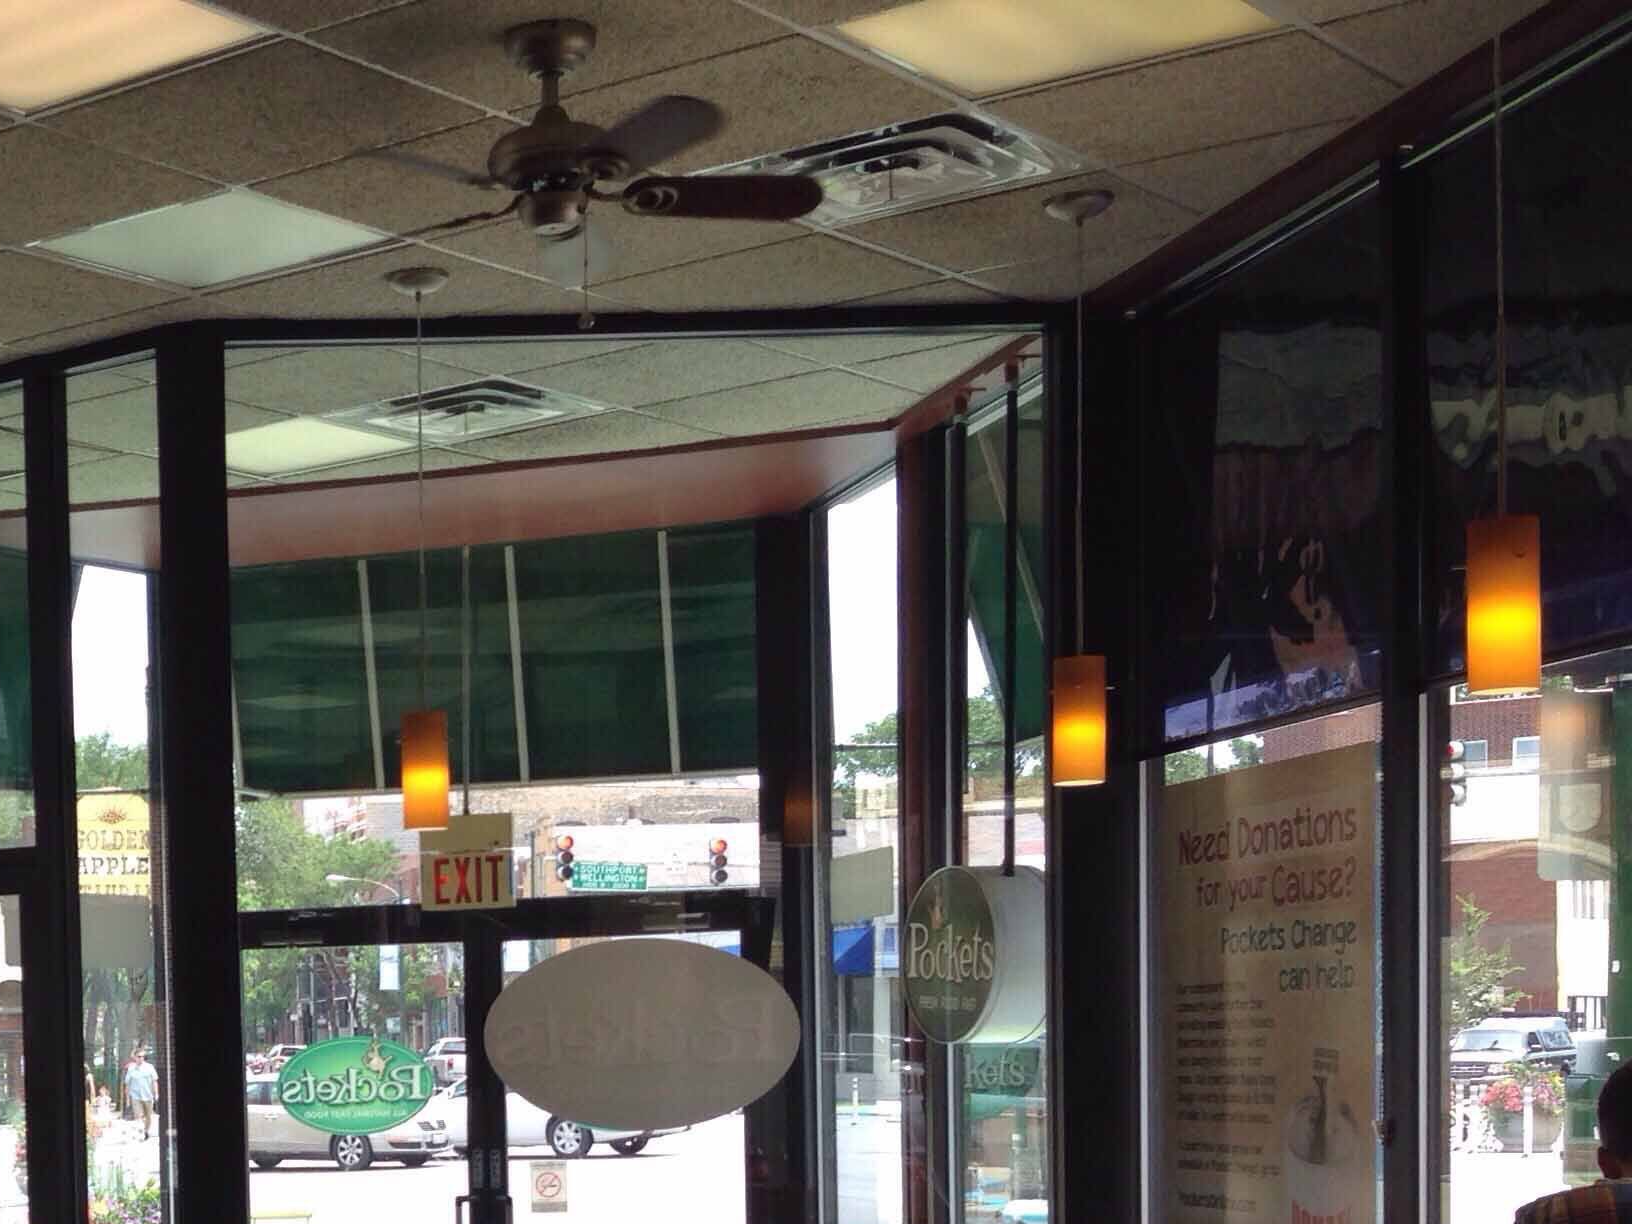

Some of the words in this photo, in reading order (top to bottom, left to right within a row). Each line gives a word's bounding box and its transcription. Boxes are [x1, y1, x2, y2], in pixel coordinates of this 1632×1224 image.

[1178, 821, 1231, 865] Need
[1238, 807, 1357, 858] Donations
[434, 854, 504, 905] EXIT
[1197, 876, 1221, 906] for
[1229, 874, 1267, 912] your
[1271, 855, 1356, 907] Cause?
[906, 922, 994, 984] Pockets
[1291, 919, 1358, 955] Change
